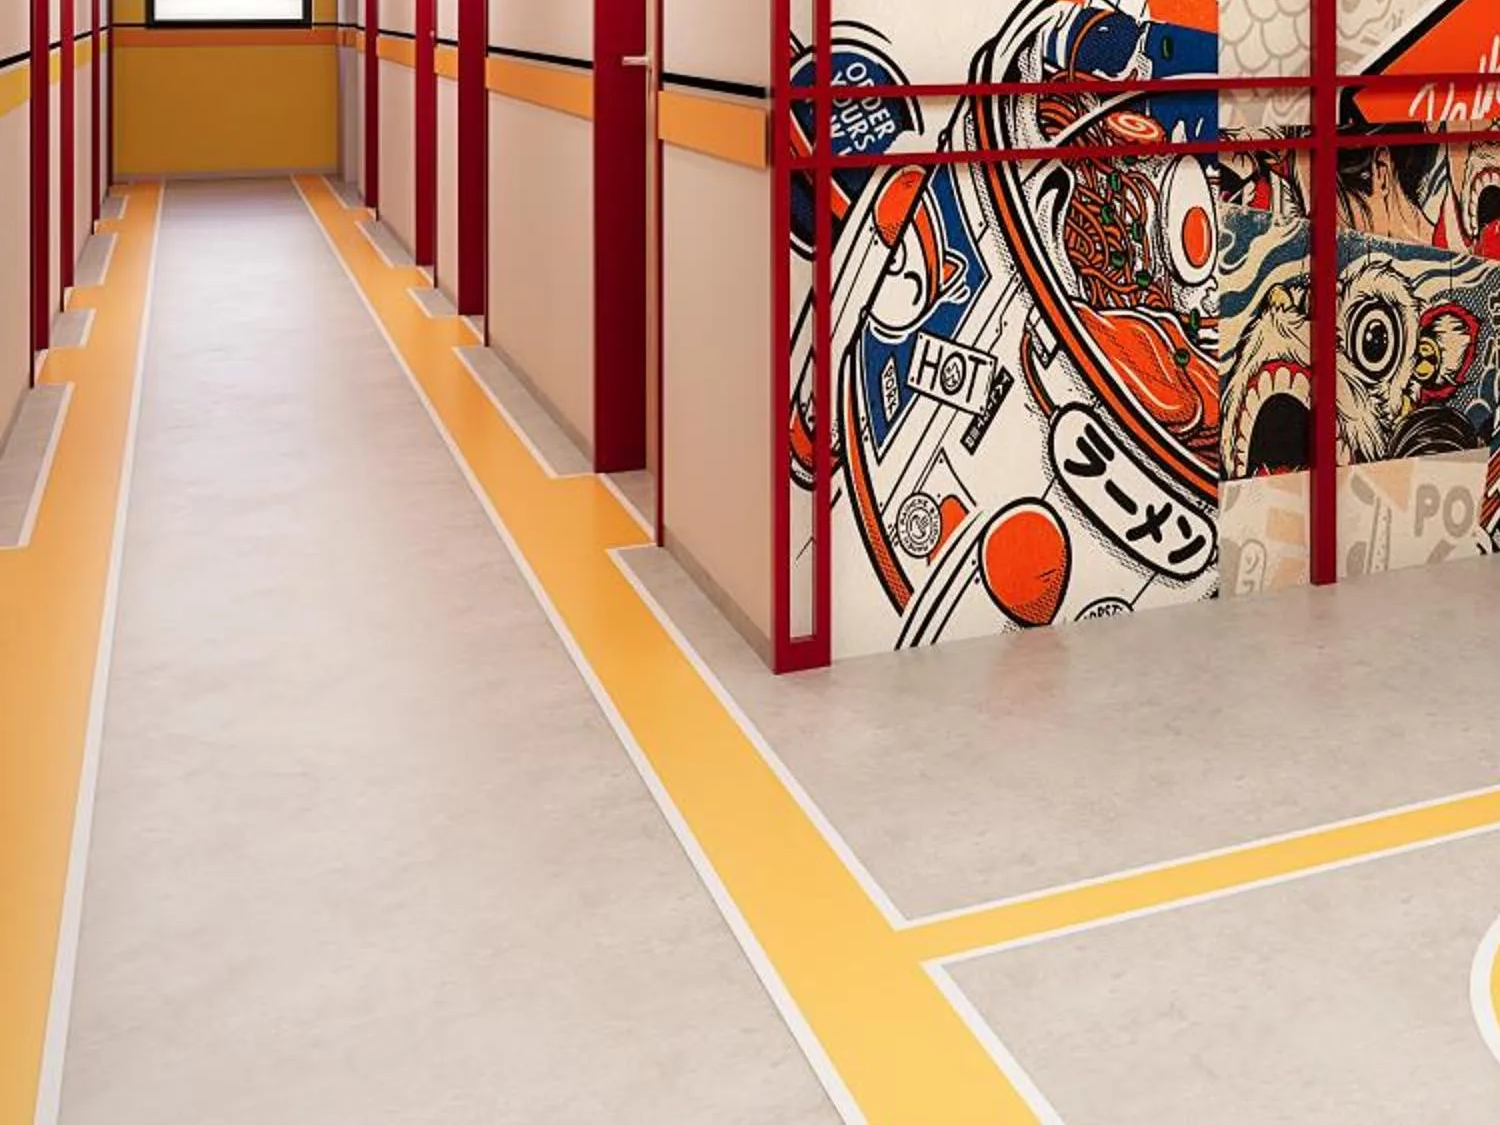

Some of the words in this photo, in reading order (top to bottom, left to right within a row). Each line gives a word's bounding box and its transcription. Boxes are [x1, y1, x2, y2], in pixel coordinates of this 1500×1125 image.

[916, 339, 988, 404] HOT
[1063, 422, 1207, 565] ラーメン
